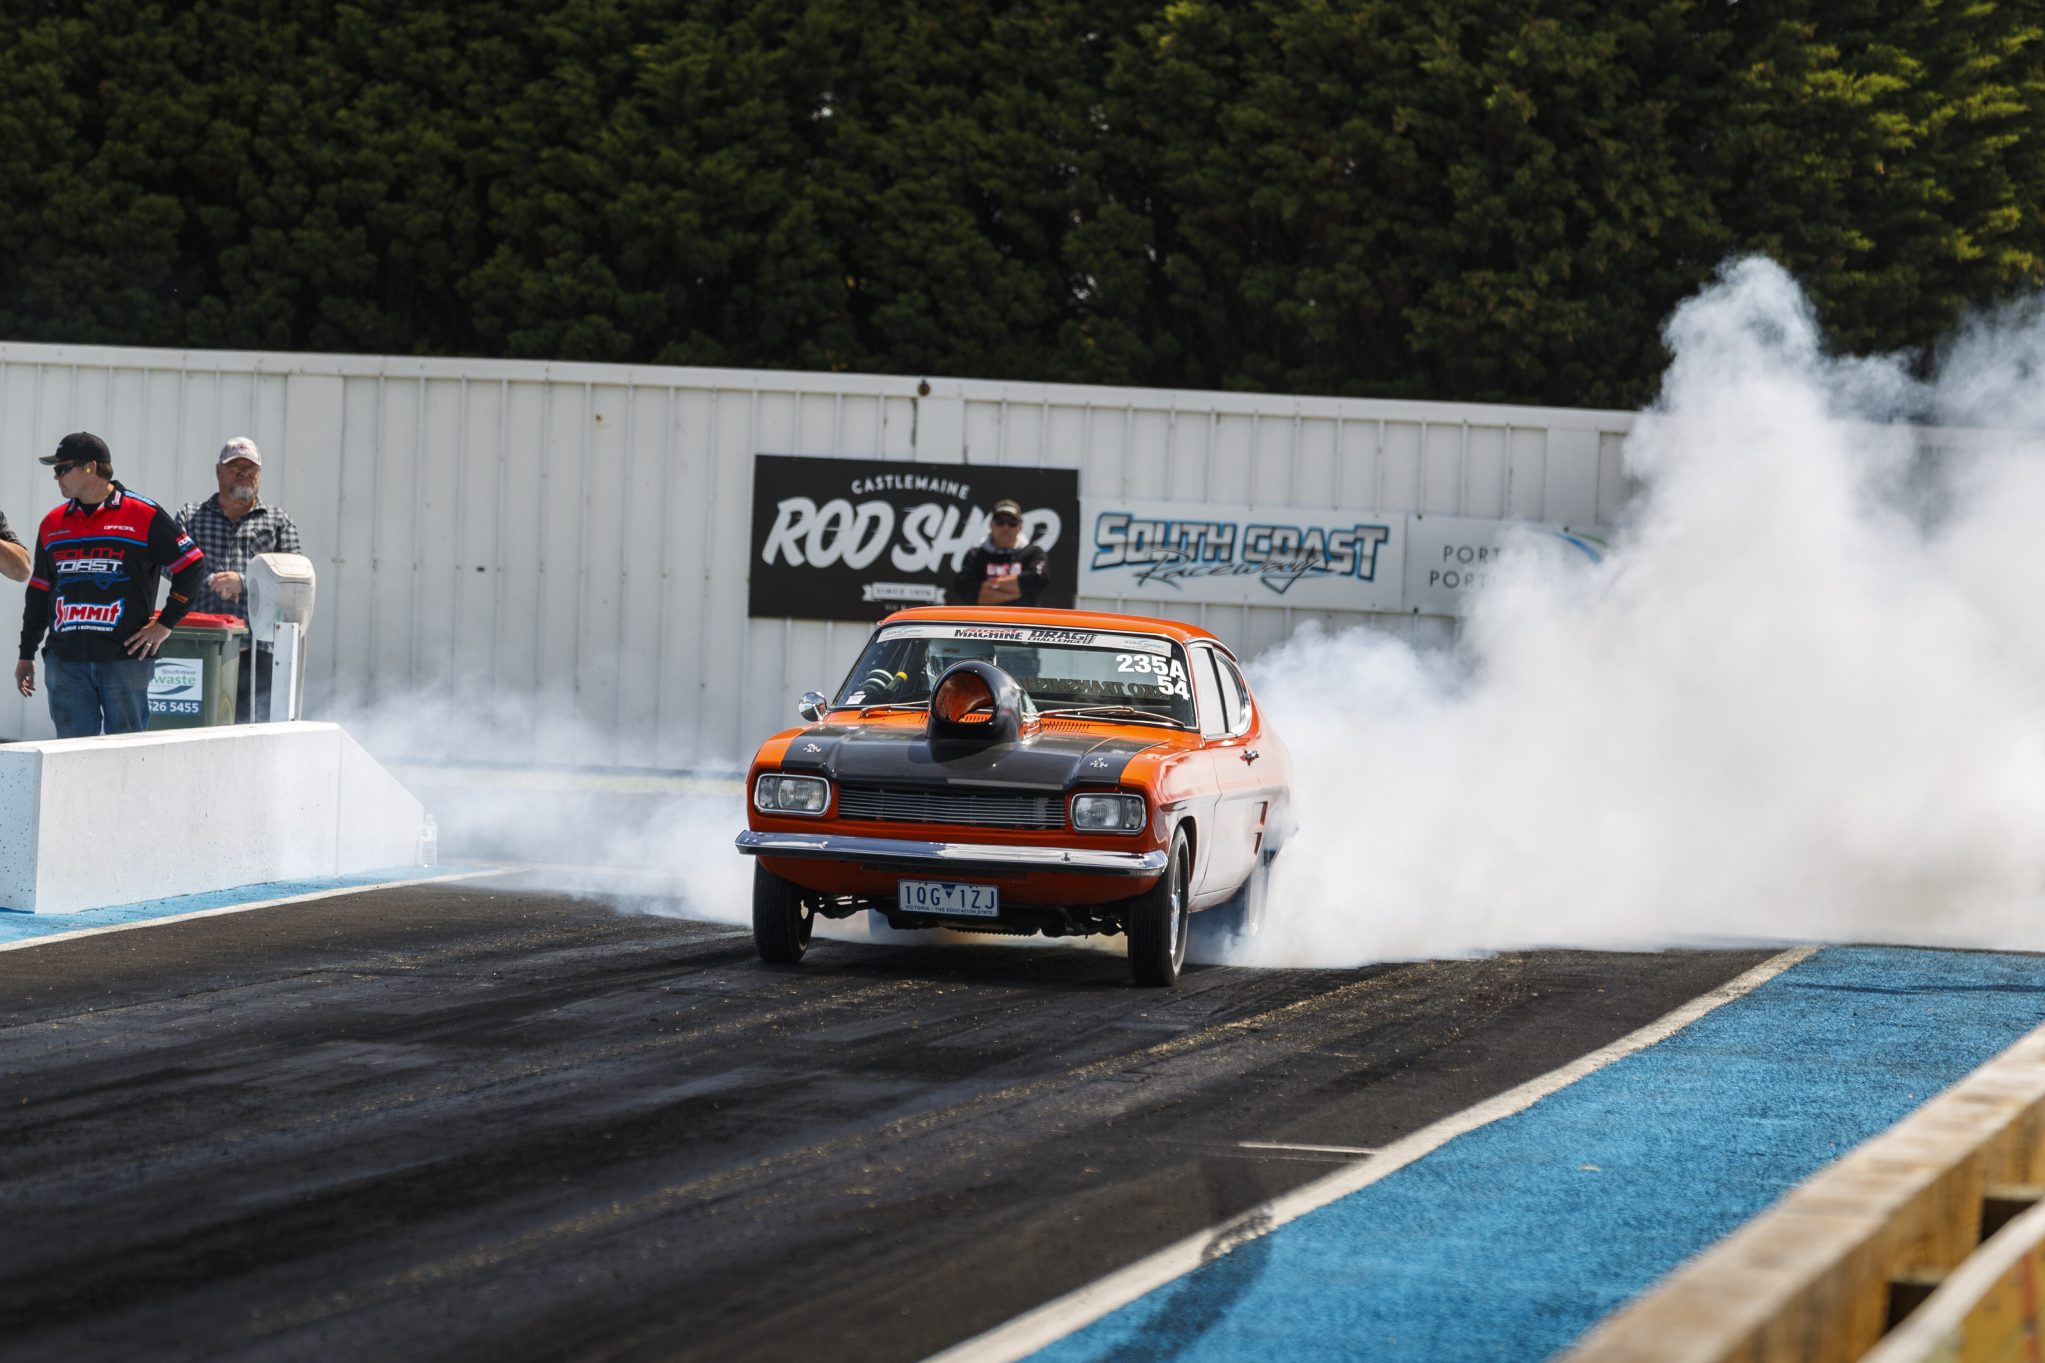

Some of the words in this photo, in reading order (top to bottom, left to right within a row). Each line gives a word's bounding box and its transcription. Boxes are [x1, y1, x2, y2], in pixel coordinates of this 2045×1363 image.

[851, 474, 971, 500] CASTLEMAINE
[762, 496, 896, 570] ROD
[891, 503, 1061, 574] SHP
[53, 547, 125, 560] SOUTH
[1091, 512, 1238, 571] SOUTH
[1242, 524, 1390, 582] COAST
[1442, 544, 1502, 564] PORT
[1134, 549, 1320, 590] Raceway
[954, 630, 1023, 641] MACHINE
[1028, 630, 1085, 641] DRAG
[1027, 637, 1082, 645] CHALLENGE
[1116, 654, 1187, 682] 235A
[154, 676, 196, 685] waste
[1157, 675, 1190, 700] 54
[169, 702, 199, 713] 5455
[960, 889, 995, 910] 1ZJ
